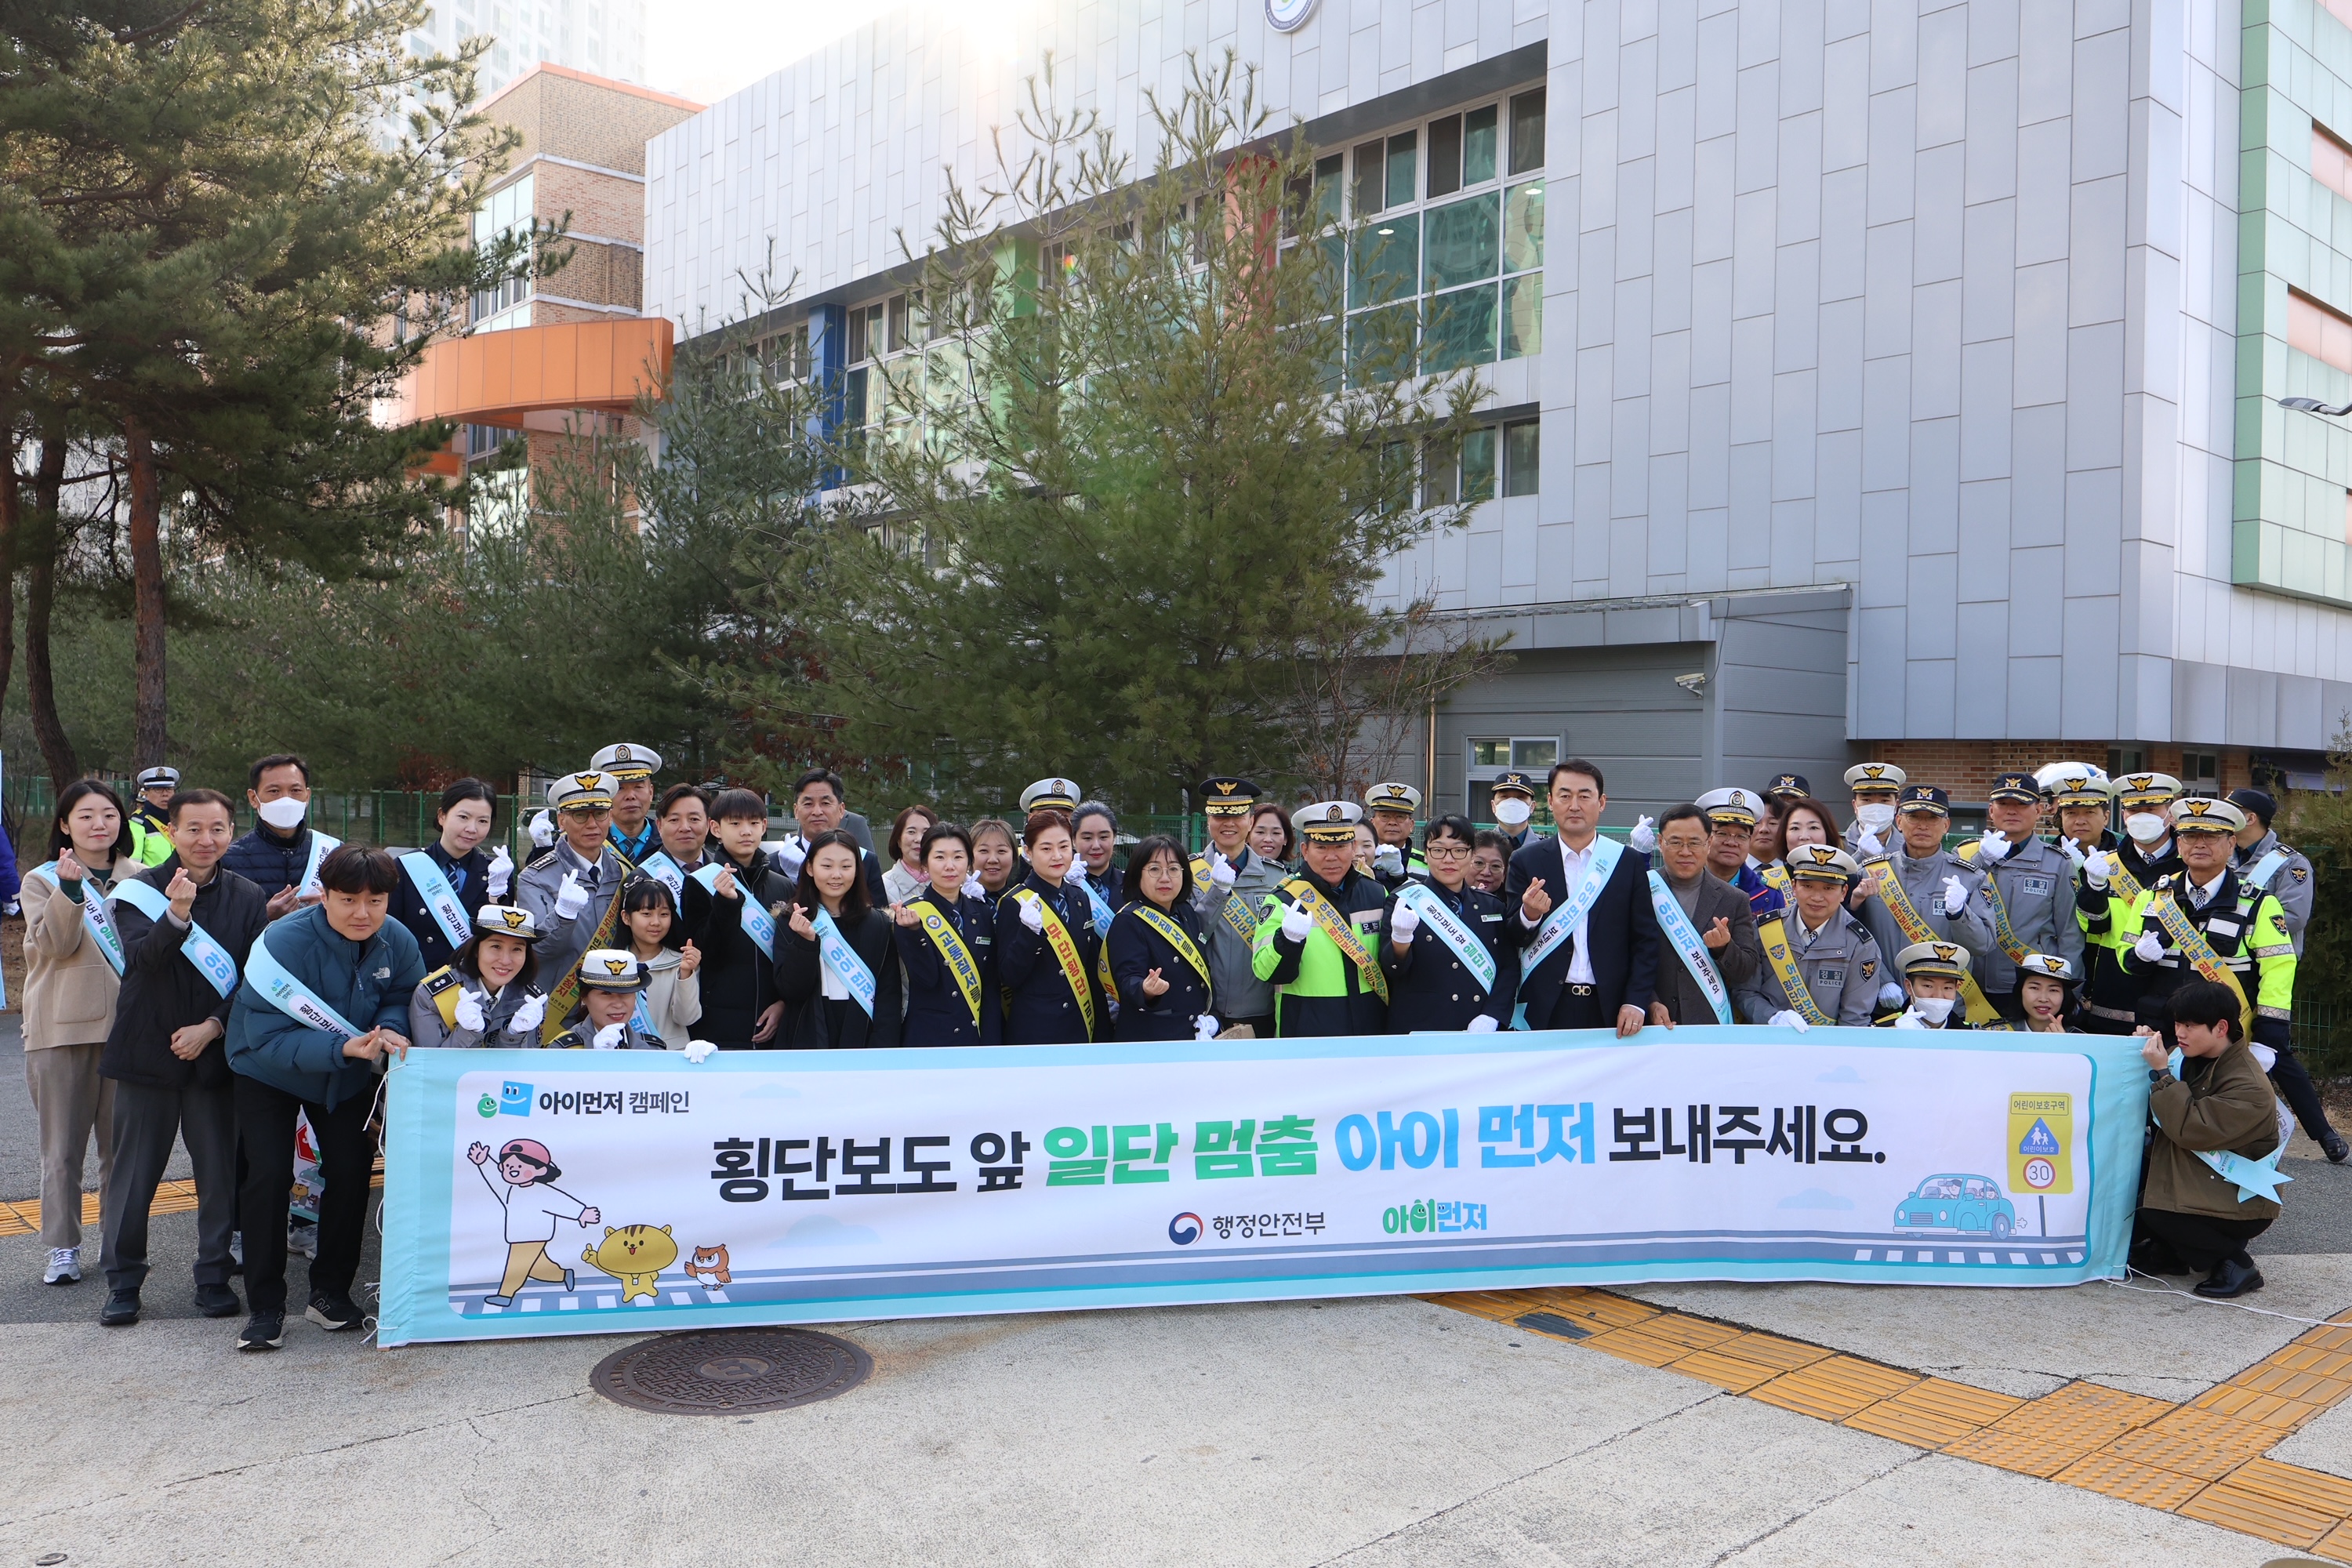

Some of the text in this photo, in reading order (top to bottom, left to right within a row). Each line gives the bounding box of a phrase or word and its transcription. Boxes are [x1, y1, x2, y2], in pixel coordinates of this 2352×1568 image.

[2026, 879, 2046, 889] 경찰
[441, 903, 470, 942] 횡단보도
[1224, 905, 1250, 935] 단보도
[1319, 901, 1366, 953] 어린이보호구역
[1528, 881, 1596, 961] 아이 먼저 보내주세요
[1886, 879, 1930, 938] 어린이보호구역 내
[1889, 902, 1921, 942] 횡단보도 앞
[750, 916, 774, 942] 아이
[1327, 926, 1358, 957] 횡단보도
[1356, 956, 1366, 966] 앞
[1426, 905, 1458, 936] 횡단보도
[1455, 934, 1466, 945] 앞
[1463, 942, 1486, 968] 일단
[1658, 901, 1720, 995] 아이 먼저 보내주세요
[2158, 907, 2191, 949] 횡단보도
[2188, 949, 2201, 962] 앞
[204, 952, 230, 980] 아이
[830, 946, 873, 998] 아이 먼저
[938, 930, 981, 1004] 교통질서를
[1047, 922, 1087, 996] 무단횡단
[1820, 970, 1842, 980] 경찰
[539, 1091, 690, 1116] 아이먼저 캠페인
[2013, 1100, 2065, 1111] 어린이보호구역
[710, 1102, 1886, 1203] 횡단보도 앞 일단 멈춤 아이 먼저 보내주세요.
[2029, 1165, 2049, 1181] 30
[1212, 1211, 1327, 1240] 행정안전부
[1382, 1199, 1487, 1233] 아이먼저
